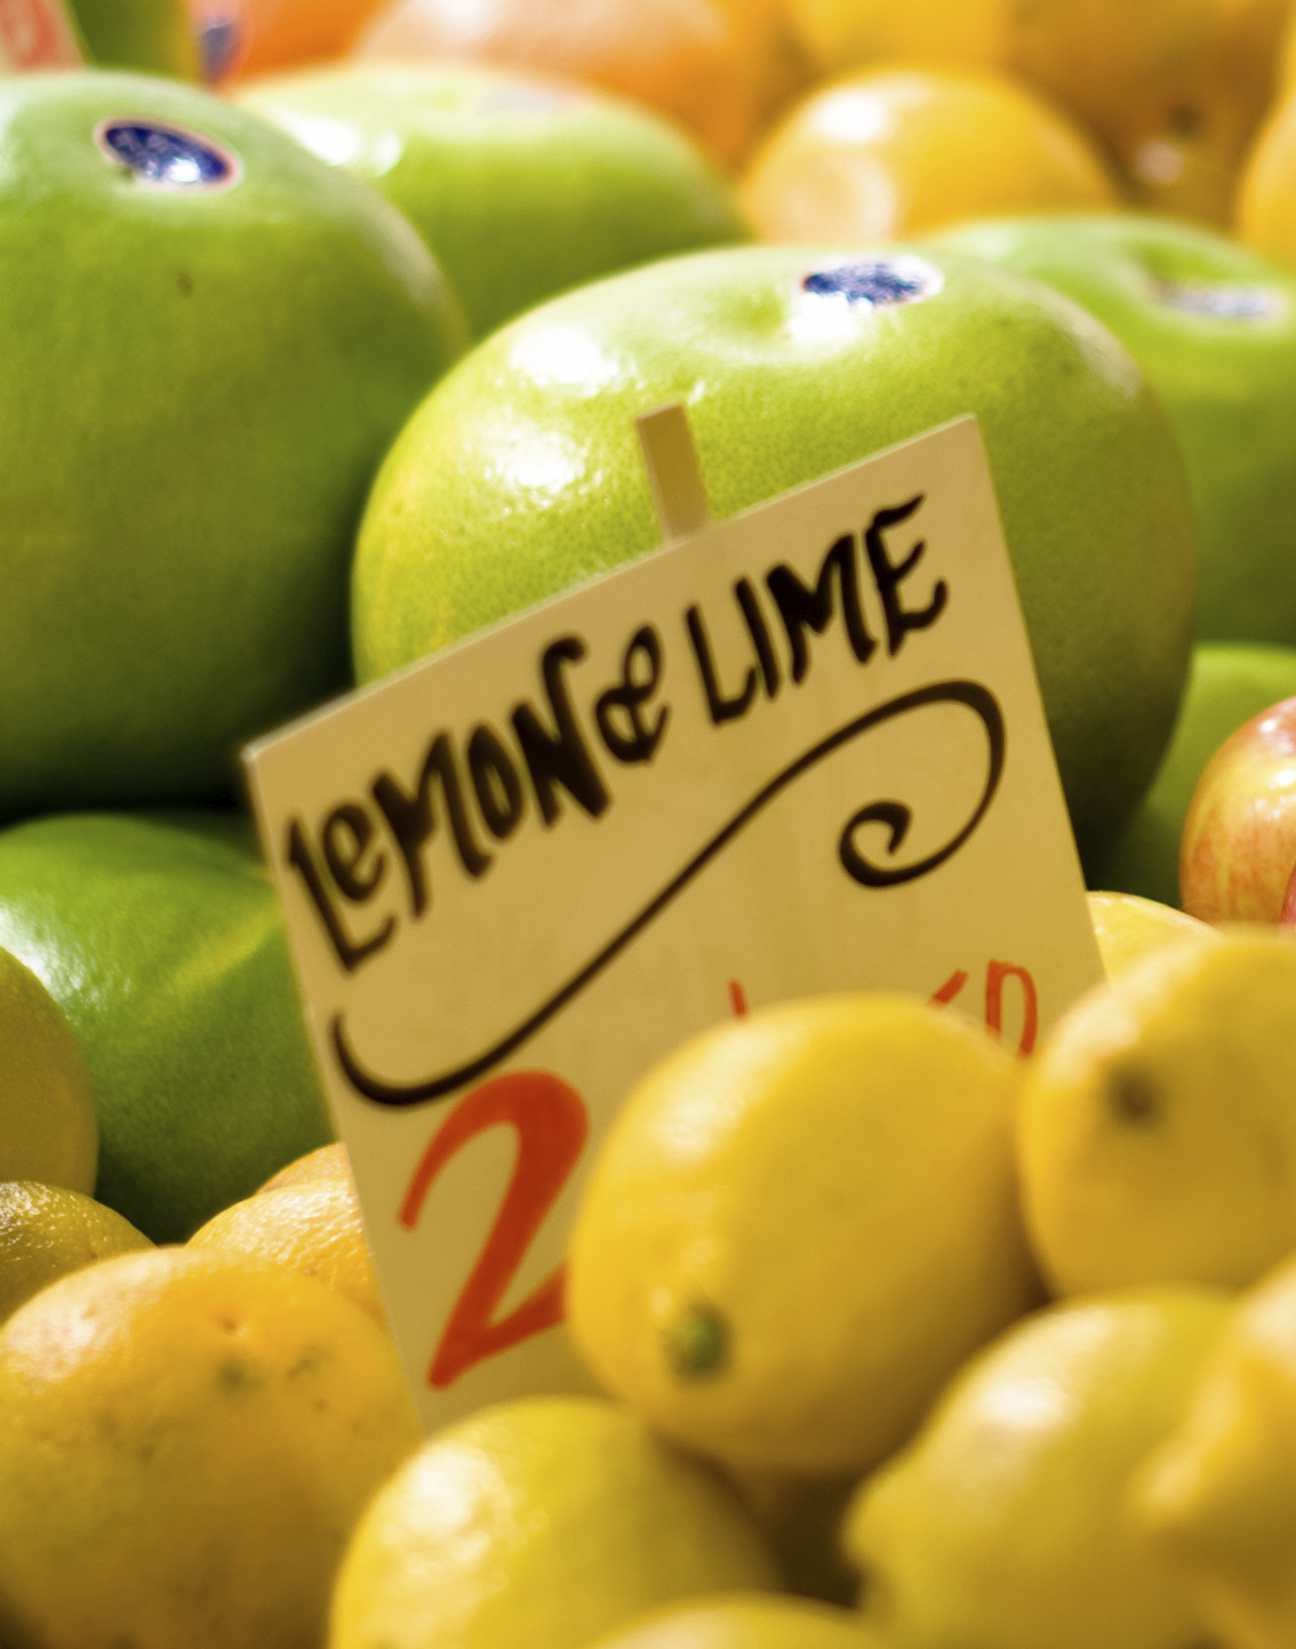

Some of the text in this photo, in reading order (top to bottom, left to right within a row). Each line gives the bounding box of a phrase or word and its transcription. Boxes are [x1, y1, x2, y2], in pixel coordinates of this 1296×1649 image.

[594, 622, 671, 768] &
[685, 492, 950, 728] LIME
[397, 1066, 590, 1390] 2
